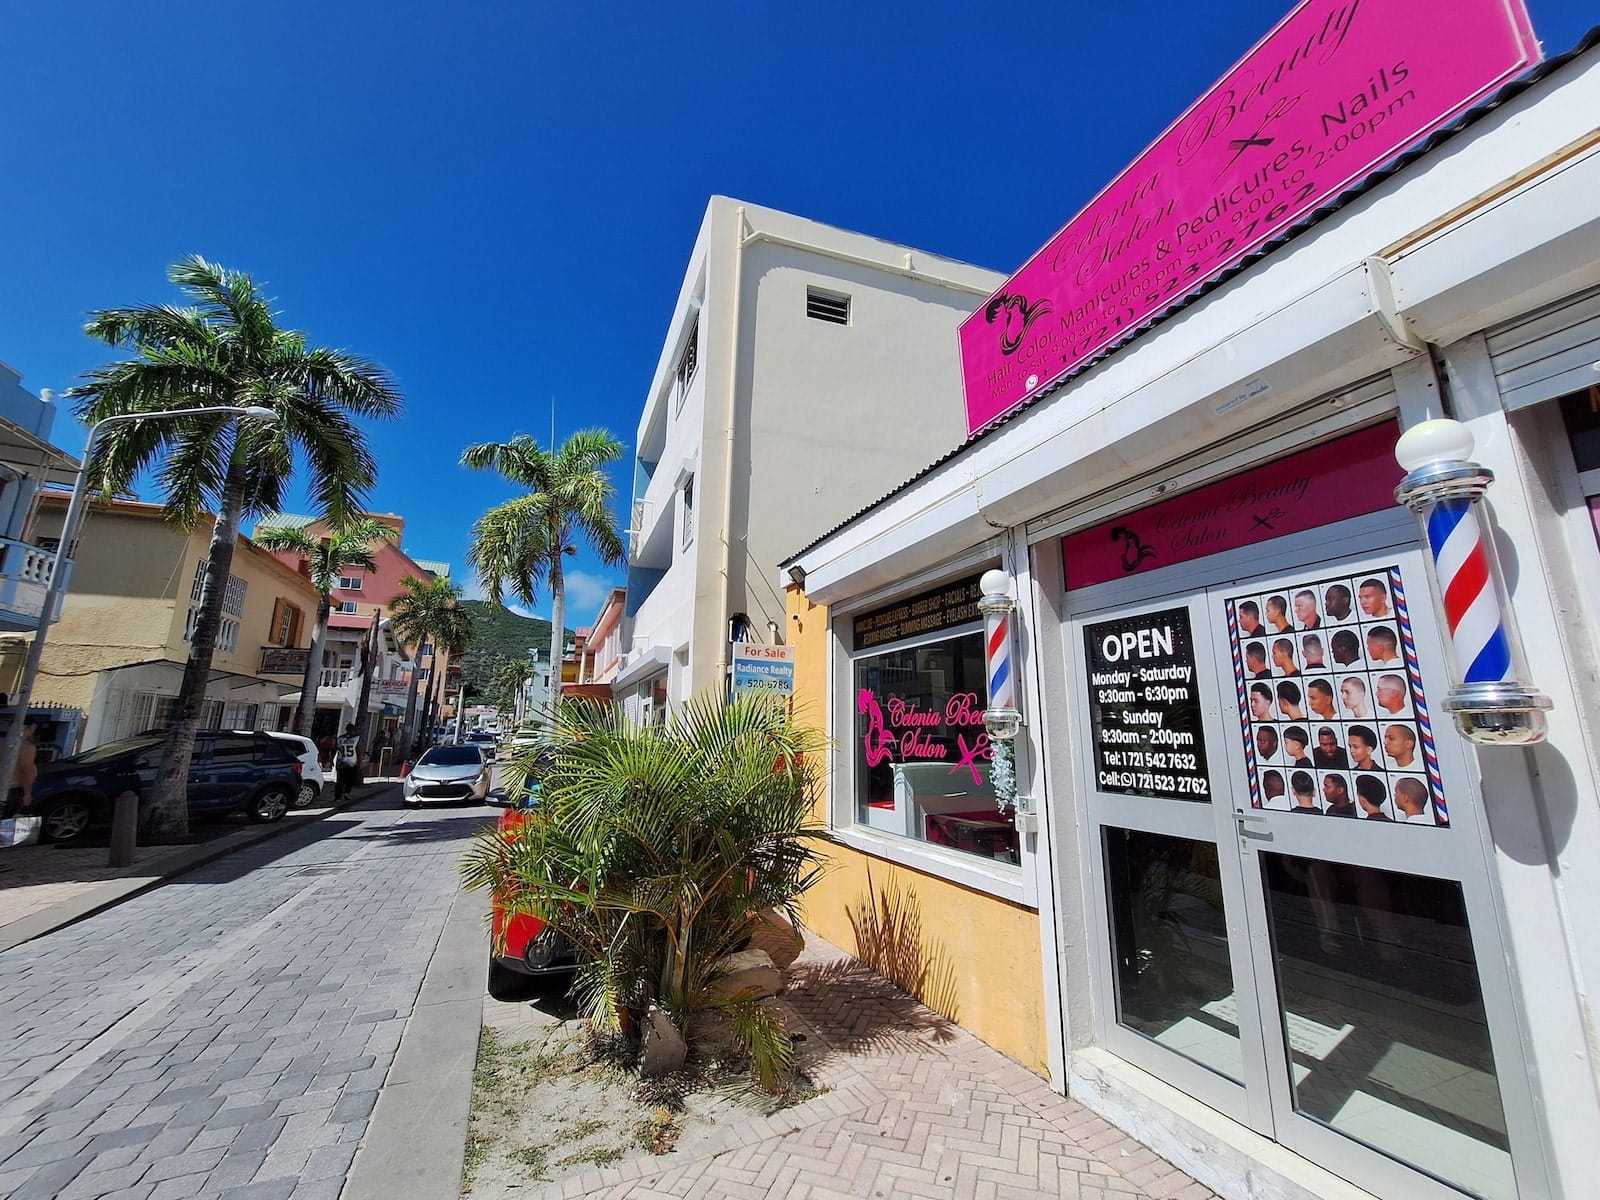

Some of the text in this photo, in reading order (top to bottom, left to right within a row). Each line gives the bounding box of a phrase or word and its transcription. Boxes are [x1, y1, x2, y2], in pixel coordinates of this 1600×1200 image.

[1176, 0, 1366, 167] Beauty
[1017, 333, 1056, 364] Color,
[1060, 257, 1149, 333] Manicures
[1156, 240, 1171, 261] &
[1176, 139, 1312, 246] Pedicures,
[1321, 60, 1409, 137] Nails
[1017, 368, 1028, 381] to
[1052, 332, 1076, 356] 9:00
[1079, 317, 1099, 338] am
[1102, 306, 1116, 319] to
[1119, 278, 1150, 306] 6:00
[1155, 257, 1182, 284] pm
[1186, 229, 1226, 258] Sun.
[1231, 188, 1275, 226] 9:00
[1281, 169, 1305, 190] to
[1312, 89, 1415, 169] 2:00pm
[1075, 198, 1175, 287] Salon
[1144, 181, 1317, 308] 523-2762
[1227, 476, 1313, 513] Beauty
[1170, 527, 1229, 551] Salon
[944, 588, 966, 606] FACIALS
[921, 612, 942, 630] MASSAGE
[946, 606, 968, 624] EYELASH
[744, 646, 786, 658] For Sale
[1102, 625, 1174, 662] OPEN
[736, 664, 793, 678] Radiance Realty
[1092, 670, 1130, 688] Monday
[1140, 664, 1192, 684] Saturday
[1098, 688, 1136, 704] 9:30am
[1145, 686, 1188, 704] 6:30pm
[944, 692, 985, 726] Bea
[1122, 709, 1163, 728] Sunday
[900, 728, 948, 762] Salon
[1102, 729, 1140, 743] 9:30am
[1150, 729, 1194, 750] 2:00pm
[1104, 751, 1196, 770] Tel: 1 721 542 7632
[1100, 771, 1208, 794] Cell: 1 721 523 2762
